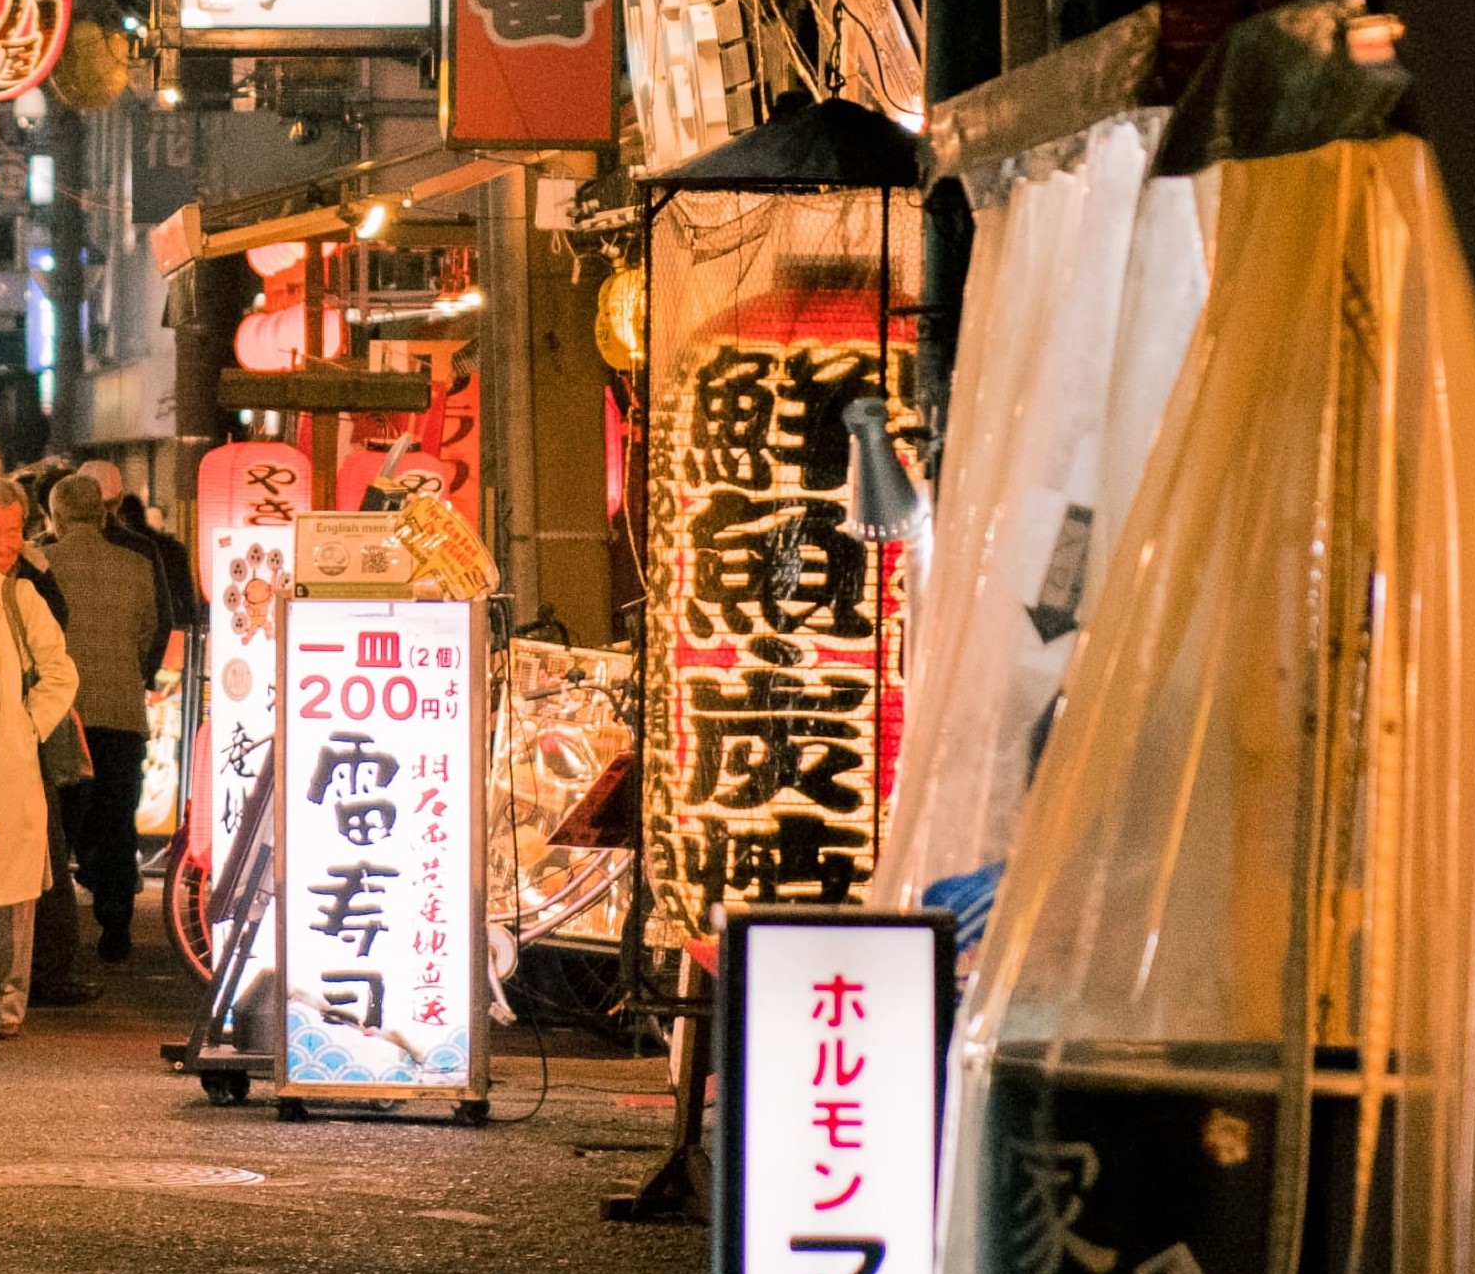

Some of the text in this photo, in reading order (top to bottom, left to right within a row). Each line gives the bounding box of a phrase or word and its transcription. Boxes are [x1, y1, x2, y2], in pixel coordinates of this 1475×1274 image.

[315, 522, 390, 534] English men
[299, 631, 402, 668] 一皿
[299, 674, 441, 722] 200円
[307, 731, 402, 1030] 雷寿司
[808, 971, 871, 1214] ホルモン
